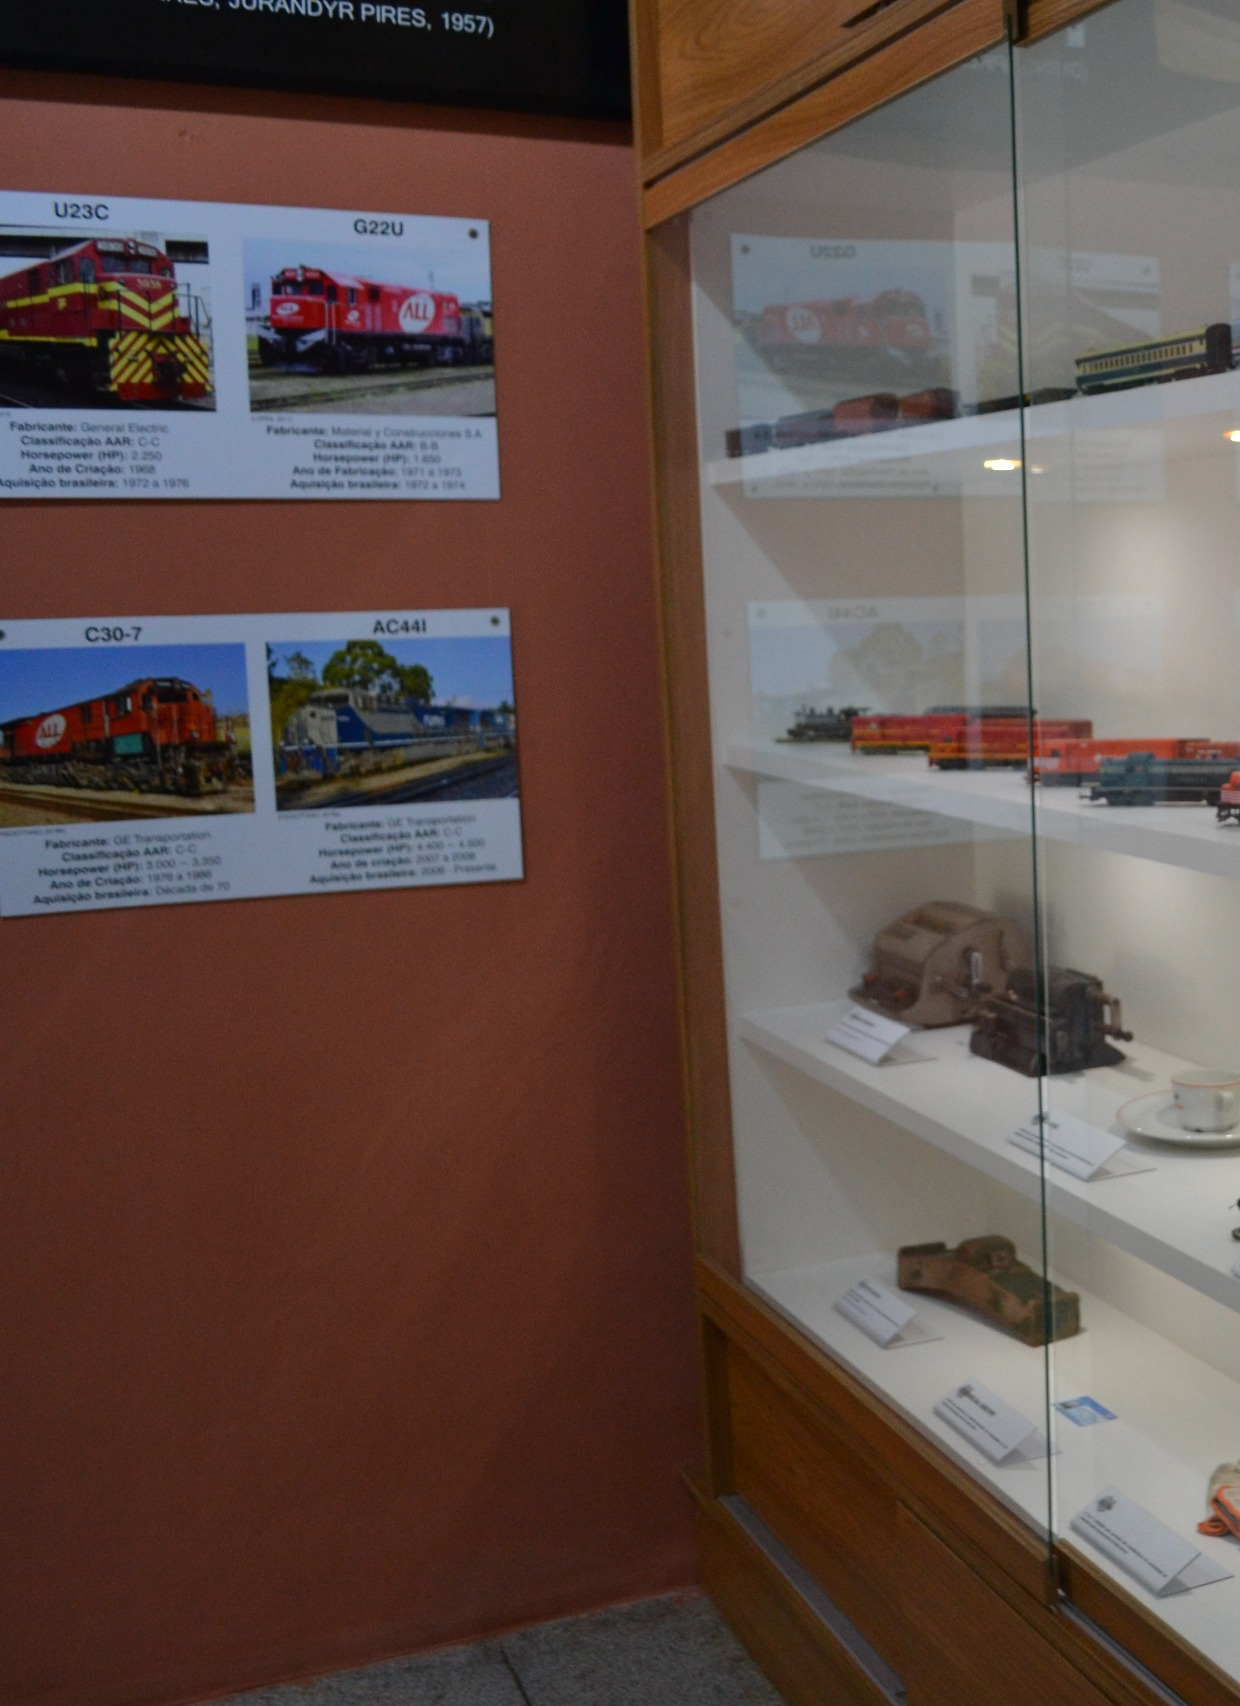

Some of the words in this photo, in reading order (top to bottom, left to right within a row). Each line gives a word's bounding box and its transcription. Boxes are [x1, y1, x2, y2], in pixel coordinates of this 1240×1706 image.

[361, 3, 432, 30] PIRES,
[442, 12, 495, 39] 1957)
[53, 202, 110, 221] U23C
[353, 220, 404, 237] G22U
[9, 421, 76, 433] Fabricante:
[80, 422, 125, 433] General
[128, 422, 169, 433] Electric
[29, 464, 53, 474] Ano
[56, 464, 71, 474] de
[85, 626, 142, 644] C30-7
